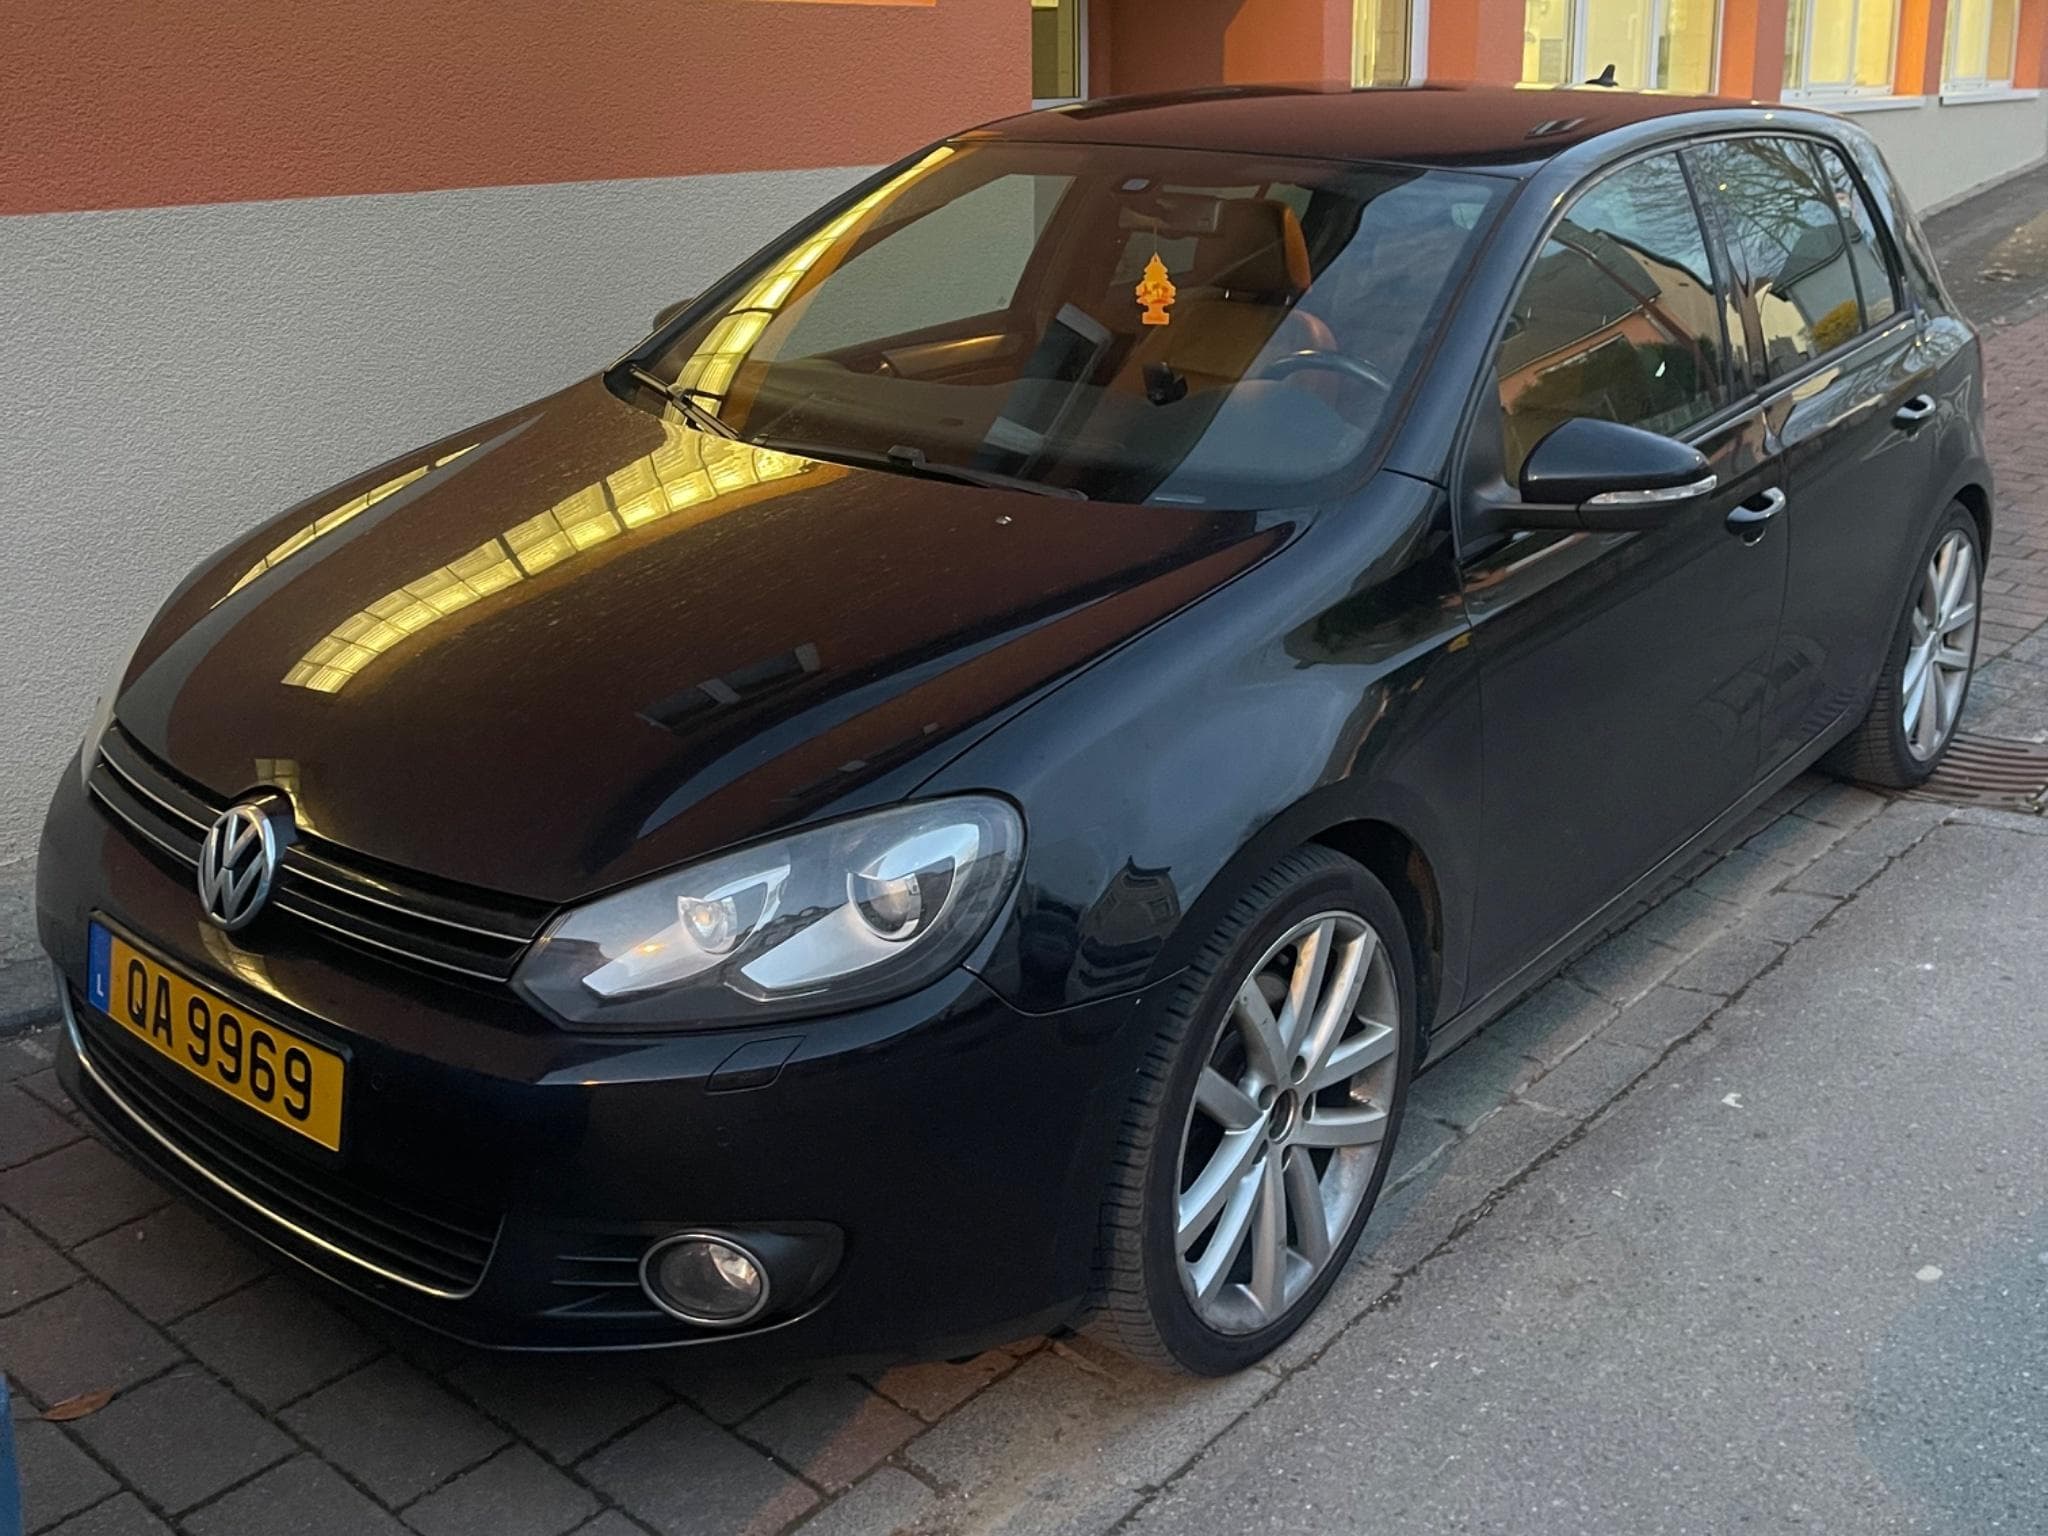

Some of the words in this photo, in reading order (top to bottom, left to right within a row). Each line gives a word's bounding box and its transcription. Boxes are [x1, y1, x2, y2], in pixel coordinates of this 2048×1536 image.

[199, 805, 275, 929] VW
[96, 973, 104, 997] L
[128, 959, 173, 1048] QA
[187, 996, 312, 1121] 9969
